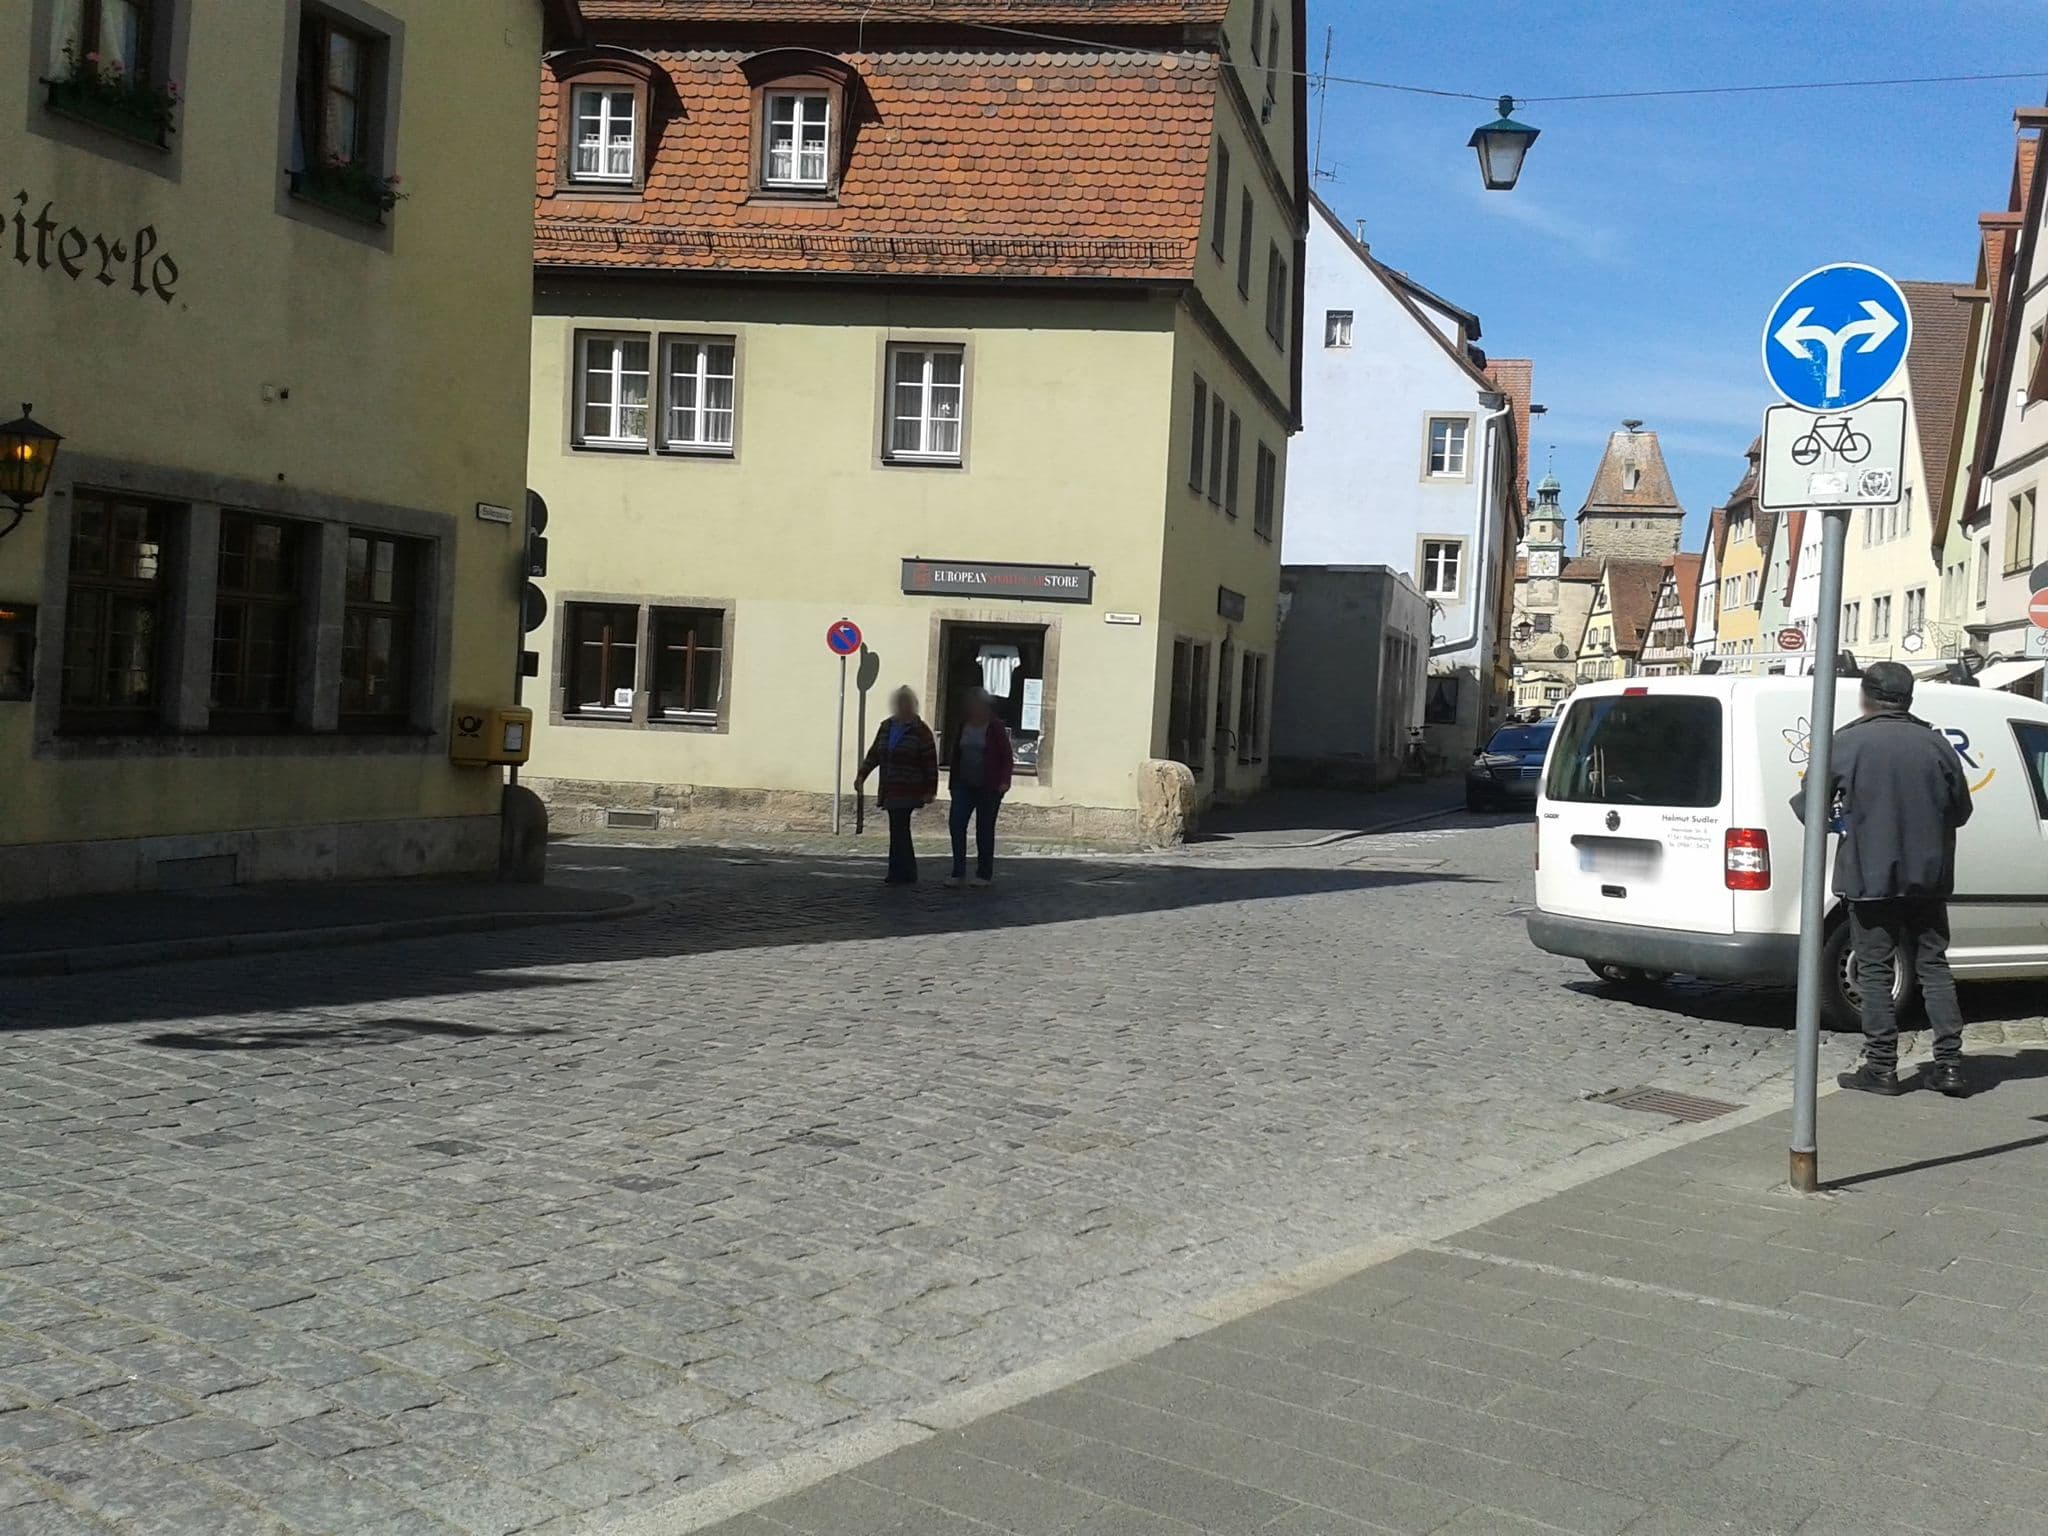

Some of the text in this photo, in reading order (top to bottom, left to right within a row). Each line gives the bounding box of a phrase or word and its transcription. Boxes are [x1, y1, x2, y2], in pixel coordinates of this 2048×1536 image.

[934, 570, 987, 584] EUROPEAN
[1044, 575, 1079, 588] STORE
[1662, 813, 1719, 824] Helmut Sudler
